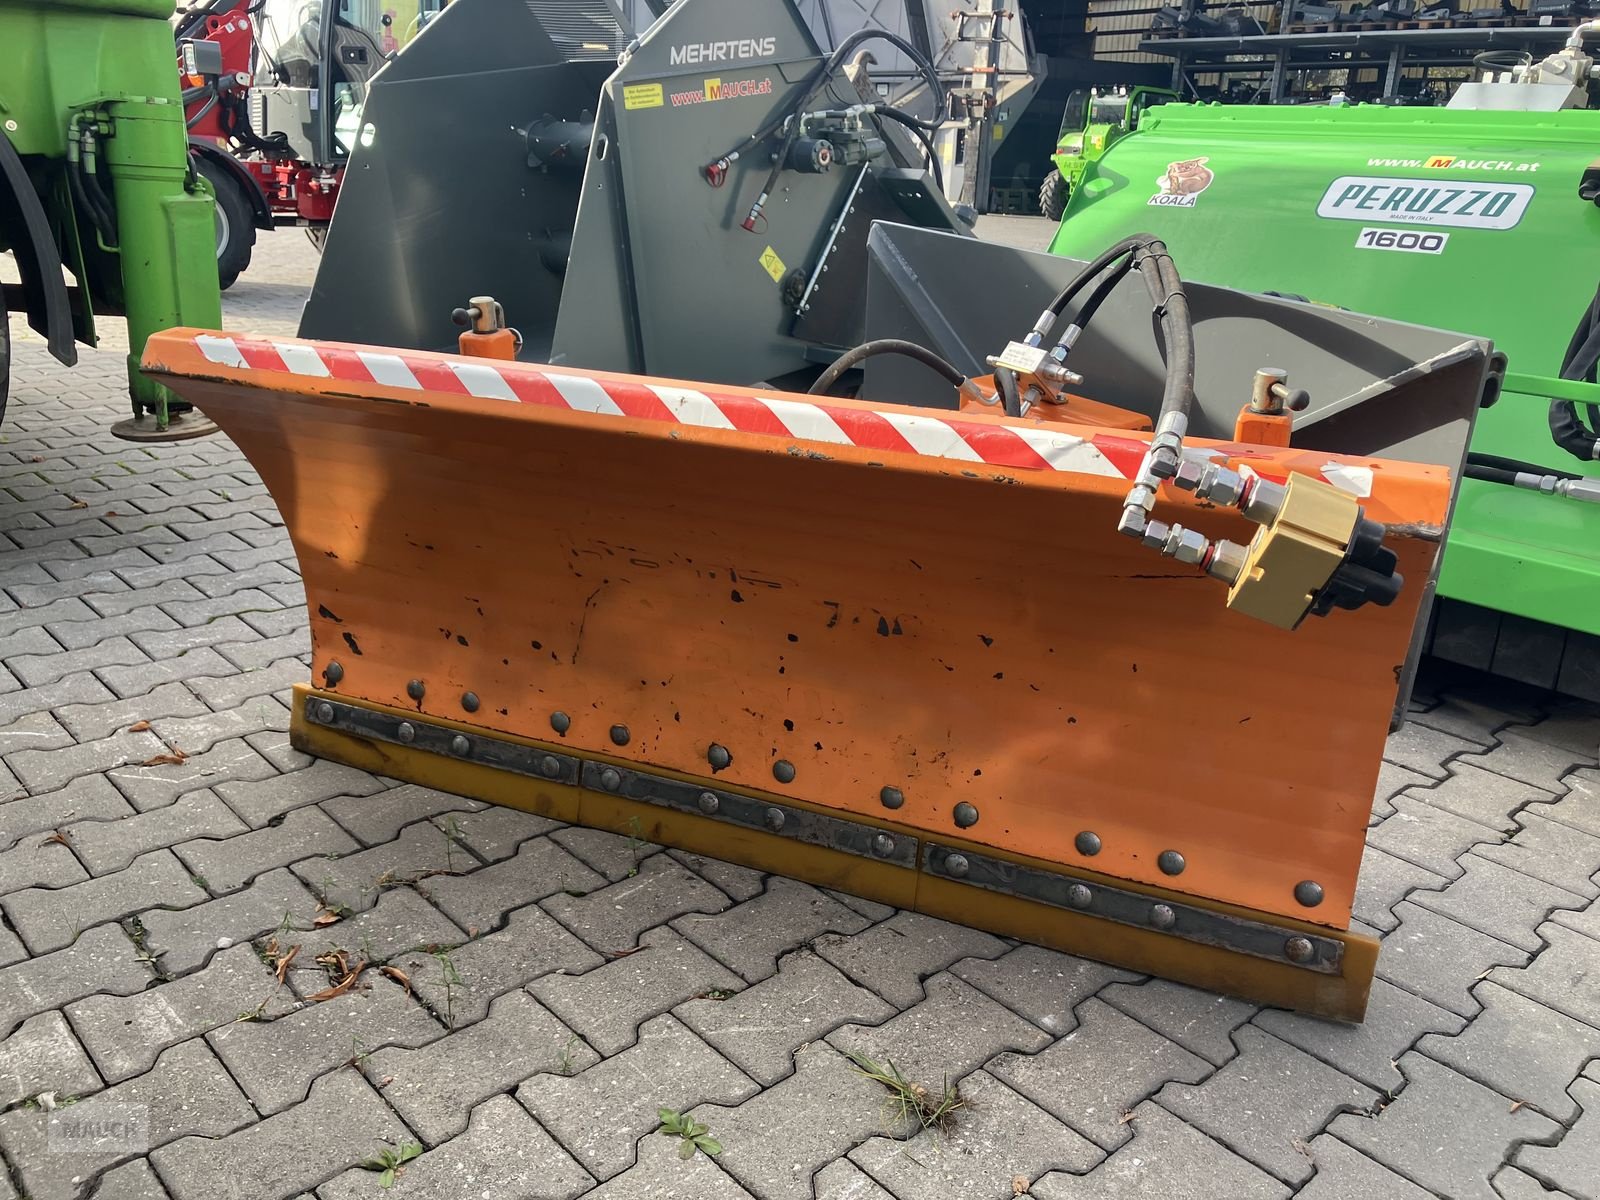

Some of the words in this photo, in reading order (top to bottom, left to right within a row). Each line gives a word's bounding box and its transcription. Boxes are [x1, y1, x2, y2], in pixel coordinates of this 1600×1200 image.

[670, 37, 776, 65] MEHRTENS
[670, 77, 772, 107] www.MAUCH.at
[1366, 157, 1541, 172] www.MAUCH.at
[1148, 195, 1196, 207] KOALA
[1332, 184, 1518, 218] PERUZZO
[1363, 231, 1444, 251] 1600
